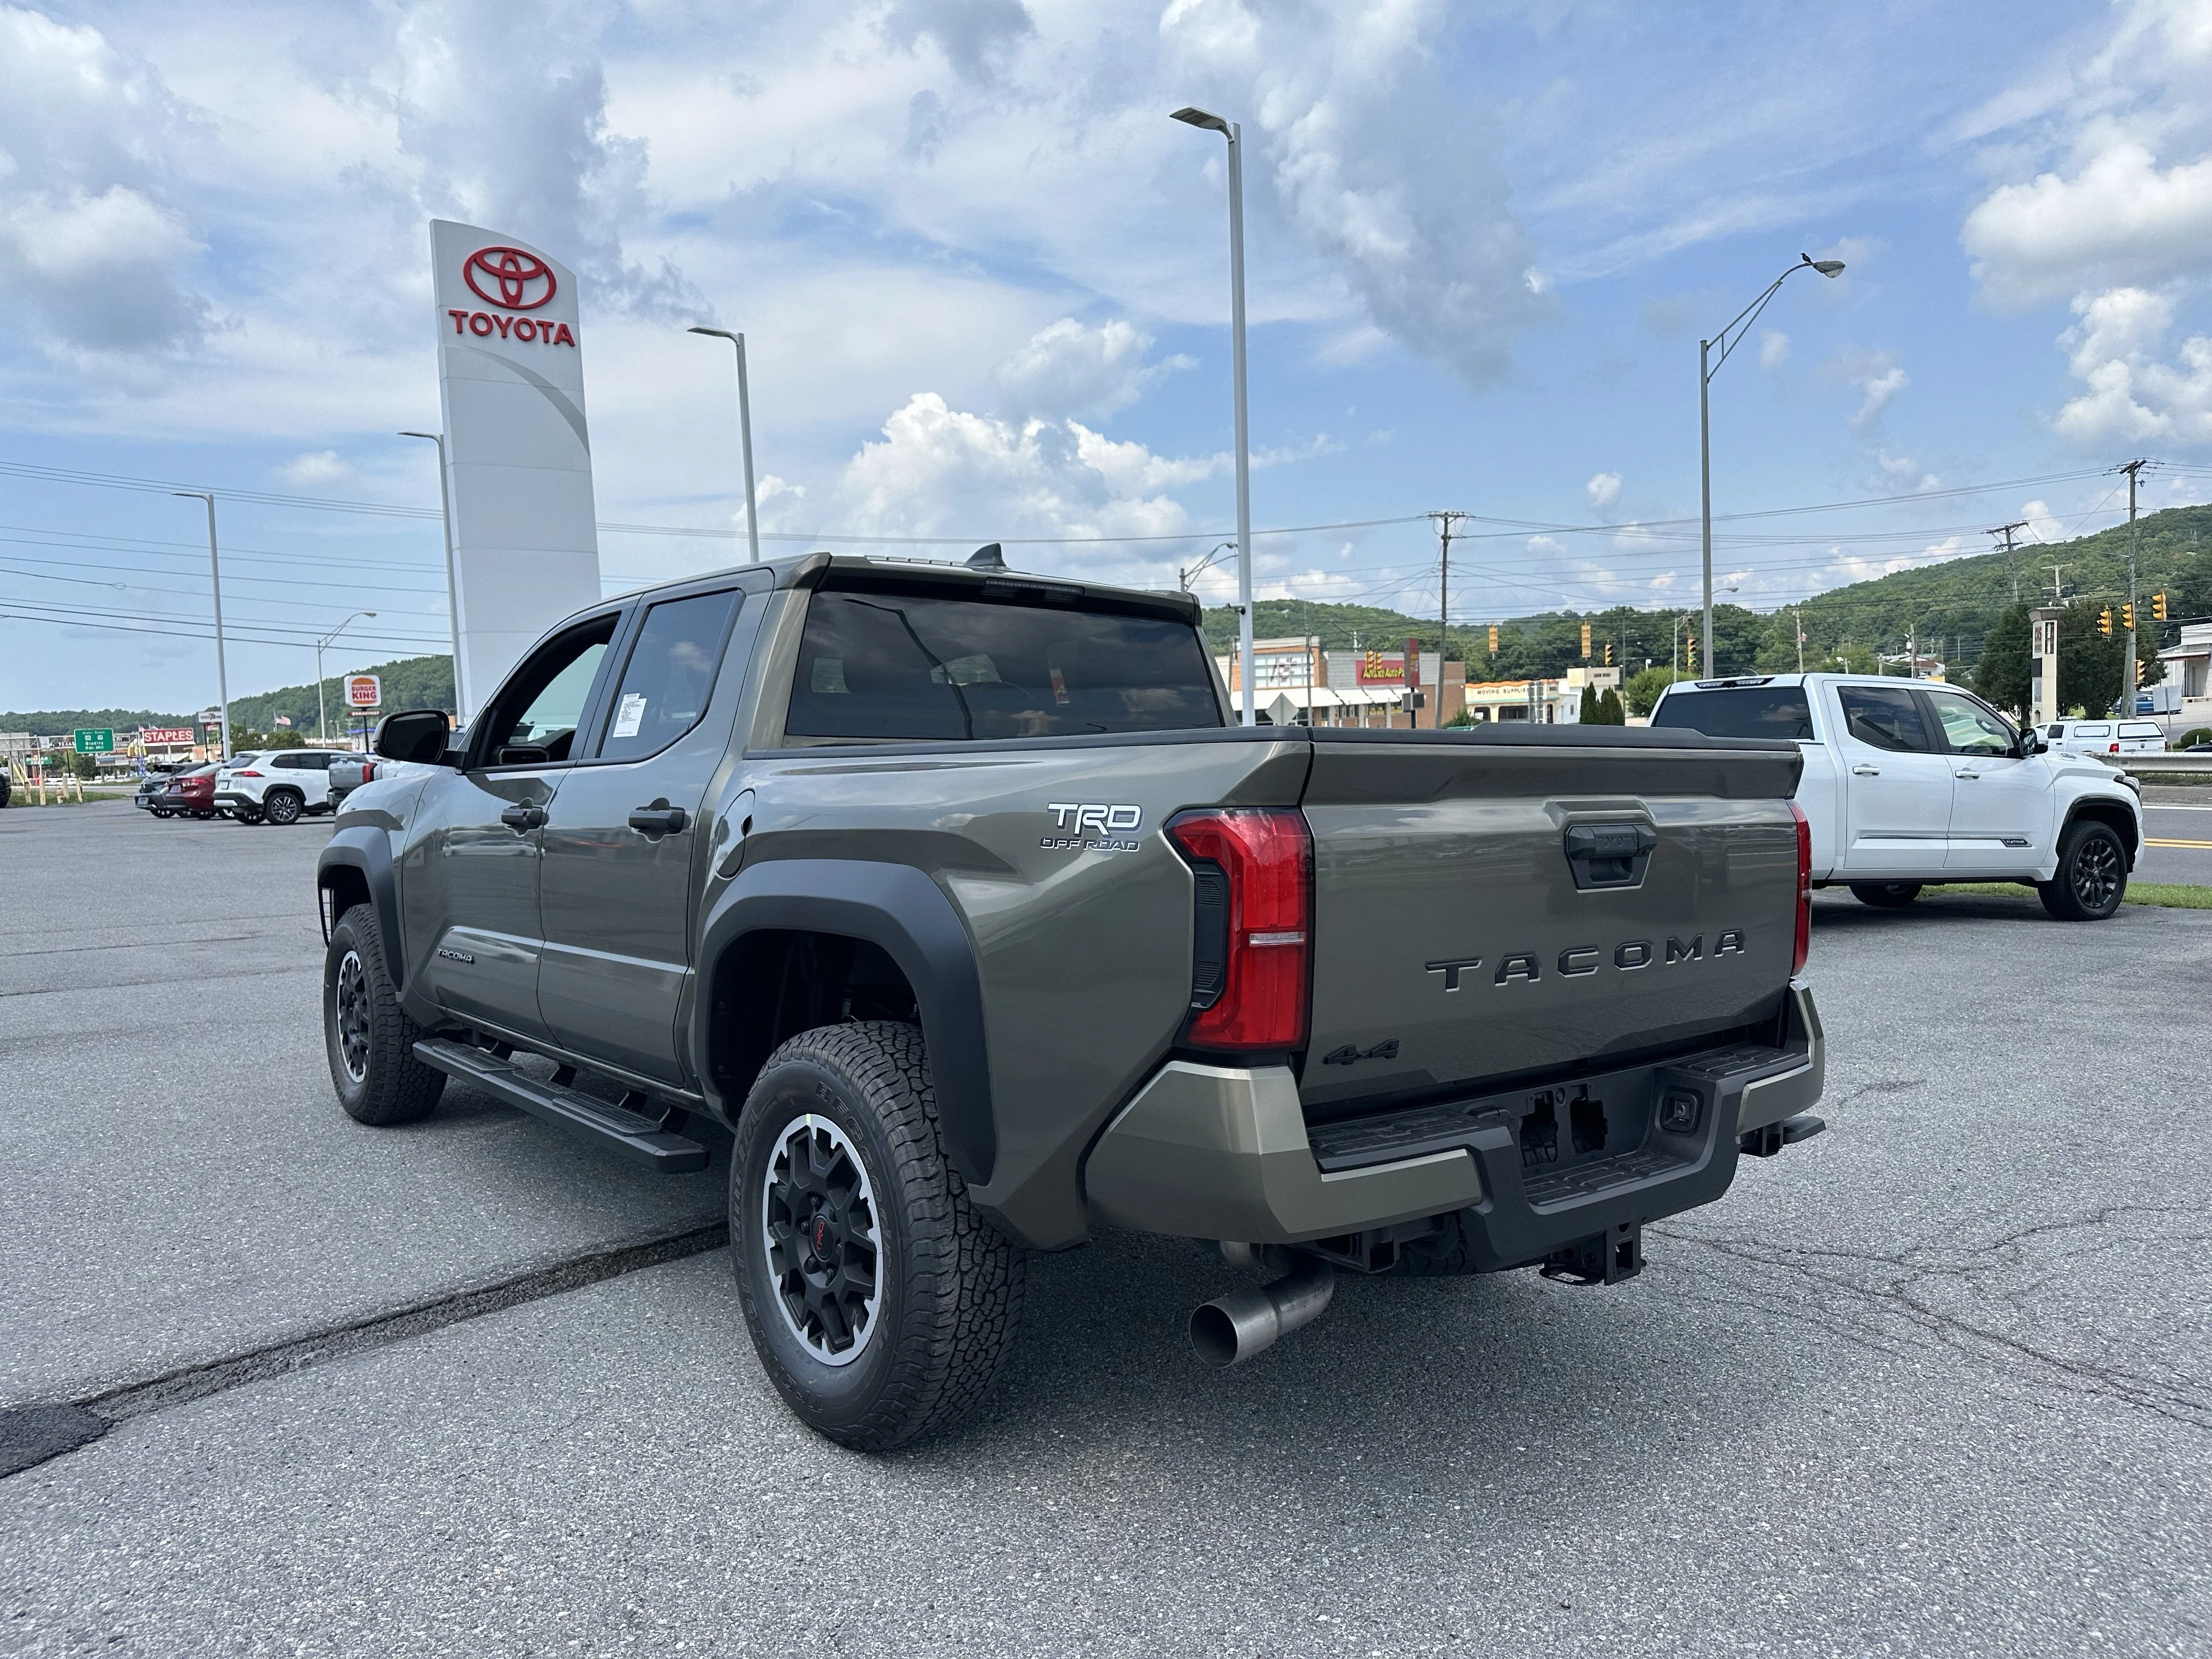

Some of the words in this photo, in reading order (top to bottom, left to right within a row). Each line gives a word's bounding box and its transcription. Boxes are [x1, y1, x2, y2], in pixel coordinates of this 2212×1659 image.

[448, 309, 576, 347] TOYOTA
[1385, 668, 1398, 678] Auto
[352, 691, 377, 699] KING
[144, 729, 194, 743] STAPLES
[1047, 802, 1144, 838] TRD
[1040, 837, 1081, 850] OFF
[1083, 839, 1141, 853] ROAD
[437, 948, 475, 964] TACOMA
[1424, 927, 1747, 993] TACOMA
